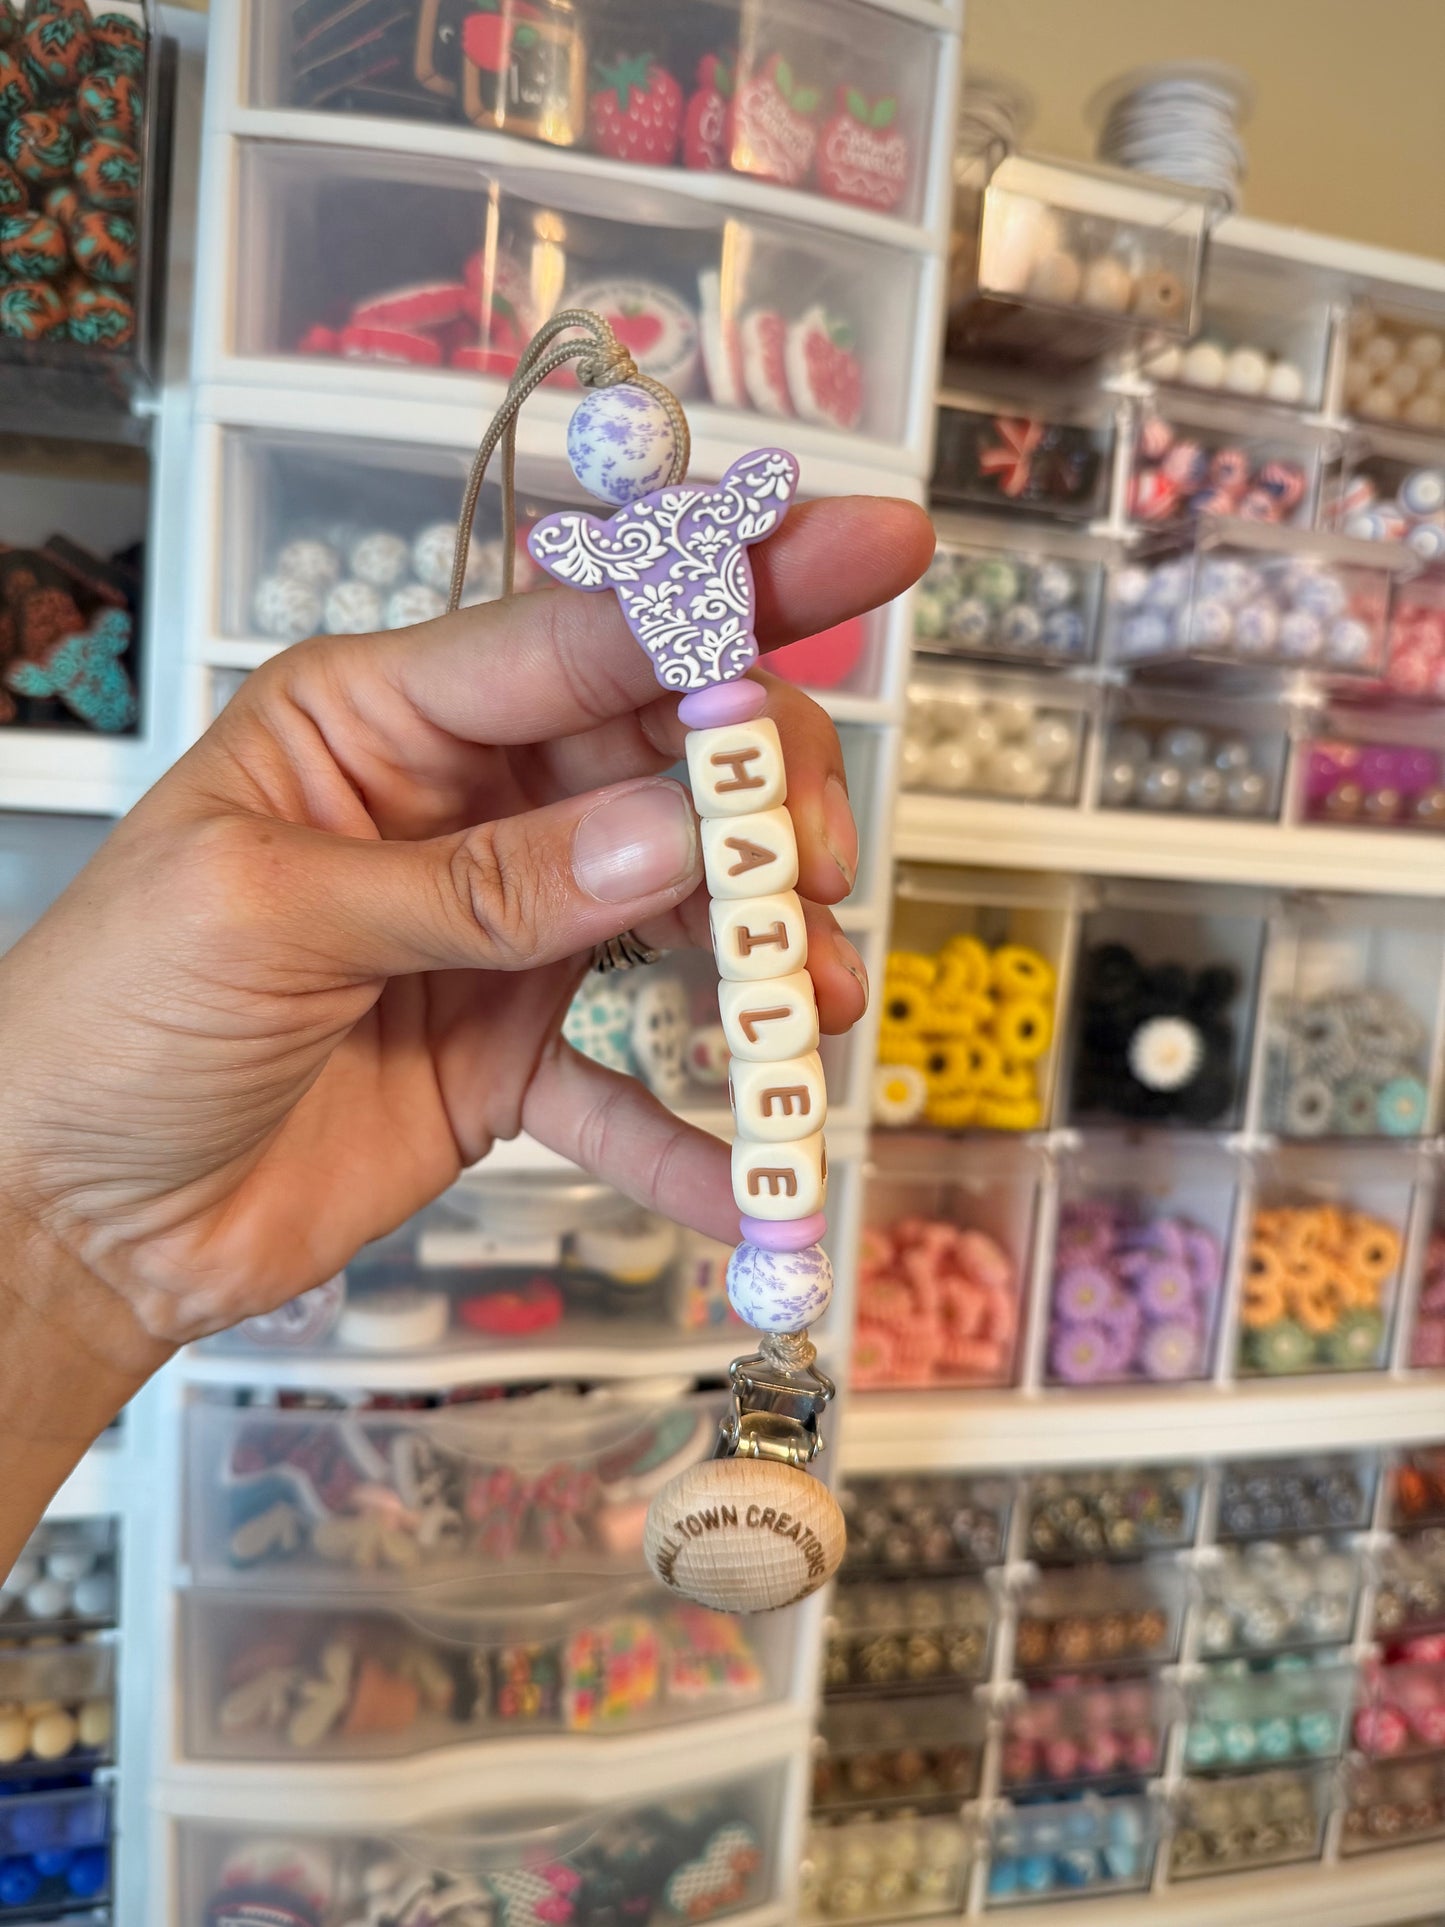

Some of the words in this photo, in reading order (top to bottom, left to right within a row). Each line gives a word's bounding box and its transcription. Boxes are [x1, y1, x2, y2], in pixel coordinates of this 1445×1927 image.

[711, 748, 811, 1197] HAILEE
[673, 1504, 738, 1541] TOWN
[746, 1504, 825, 1578] CREATIONS
